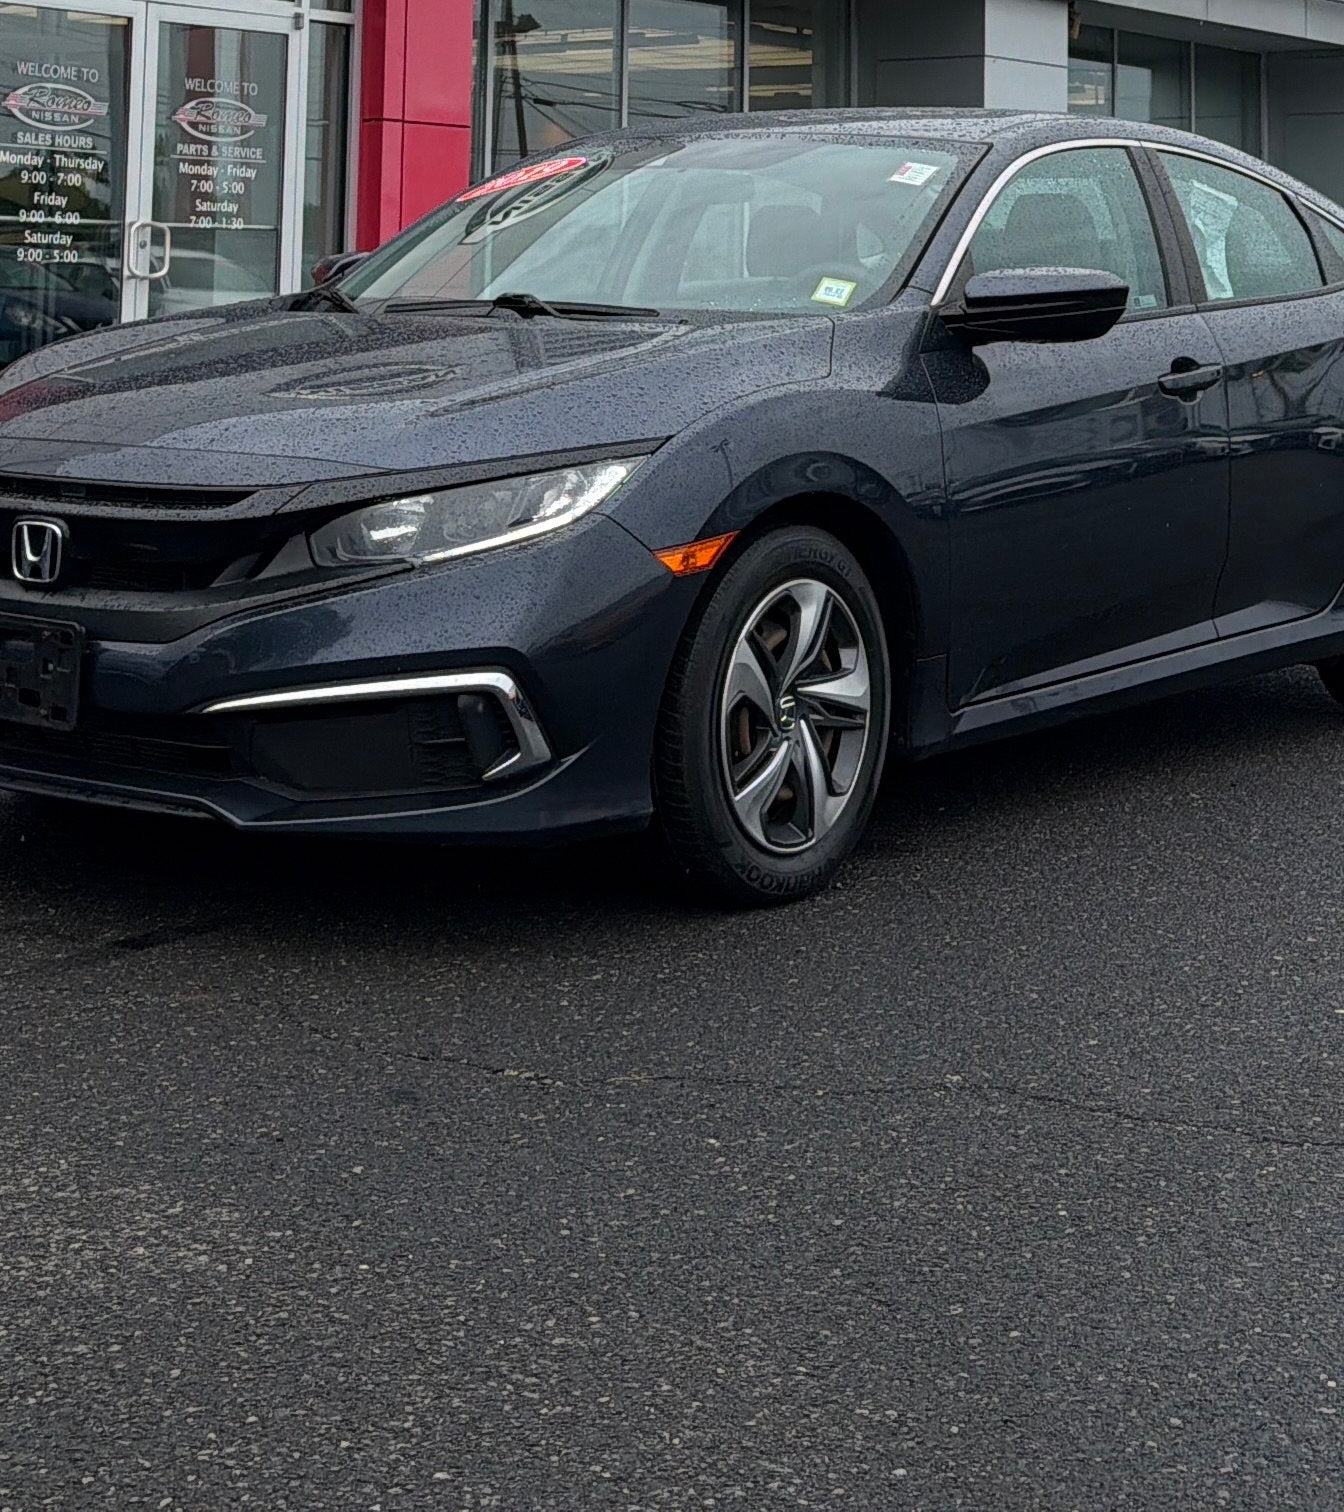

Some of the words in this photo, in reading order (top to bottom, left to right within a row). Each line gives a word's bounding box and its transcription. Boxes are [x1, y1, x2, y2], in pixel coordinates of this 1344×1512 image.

[16, 61, 77, 80] WELCOME
[81, 67, 99, 83] TO
[185, 77, 240, 94] WELCOME
[242, 82, 259, 96] TO
[22, 86, 92, 110] Romeo
[31, 110, 80, 124] NISSAN
[191, 101, 252, 124] Romeo
[198, 124, 242, 135] NISSAN
[16, 131, 53, 146] SALES
[54, 134, 93, 149] HOURS
[176, 143, 209, 156] PARTS
[211, 145, 219, 157] &
[221, 146, 263, 159] SERVICE
[0, 150, 45, 167] Monday
[54, 154, 105, 172] Thursday
[20, 170, 47, 184] 9:00
[56, 172, 82, 186] 7:00
[178, 161, 219, 178] Monday
[227, 164, 257, 180] Friday
[190, 179, 214, 193] 7:00
[223, 181, 245, 195] 5:00
[33, 191, 68, 208] Friday
[195, 199, 239, 215] Saturday
[18, 209, 45, 223] 9:00
[54, 211, 81, 225] 6:00
[189, 215, 213, 228] 7:00
[222, 218, 244, 230] 1:30
[23, 229, 74, 247] Saturday
[16, 248, 43, 262] 9:00
[53, 250, 78, 263] 5:00
